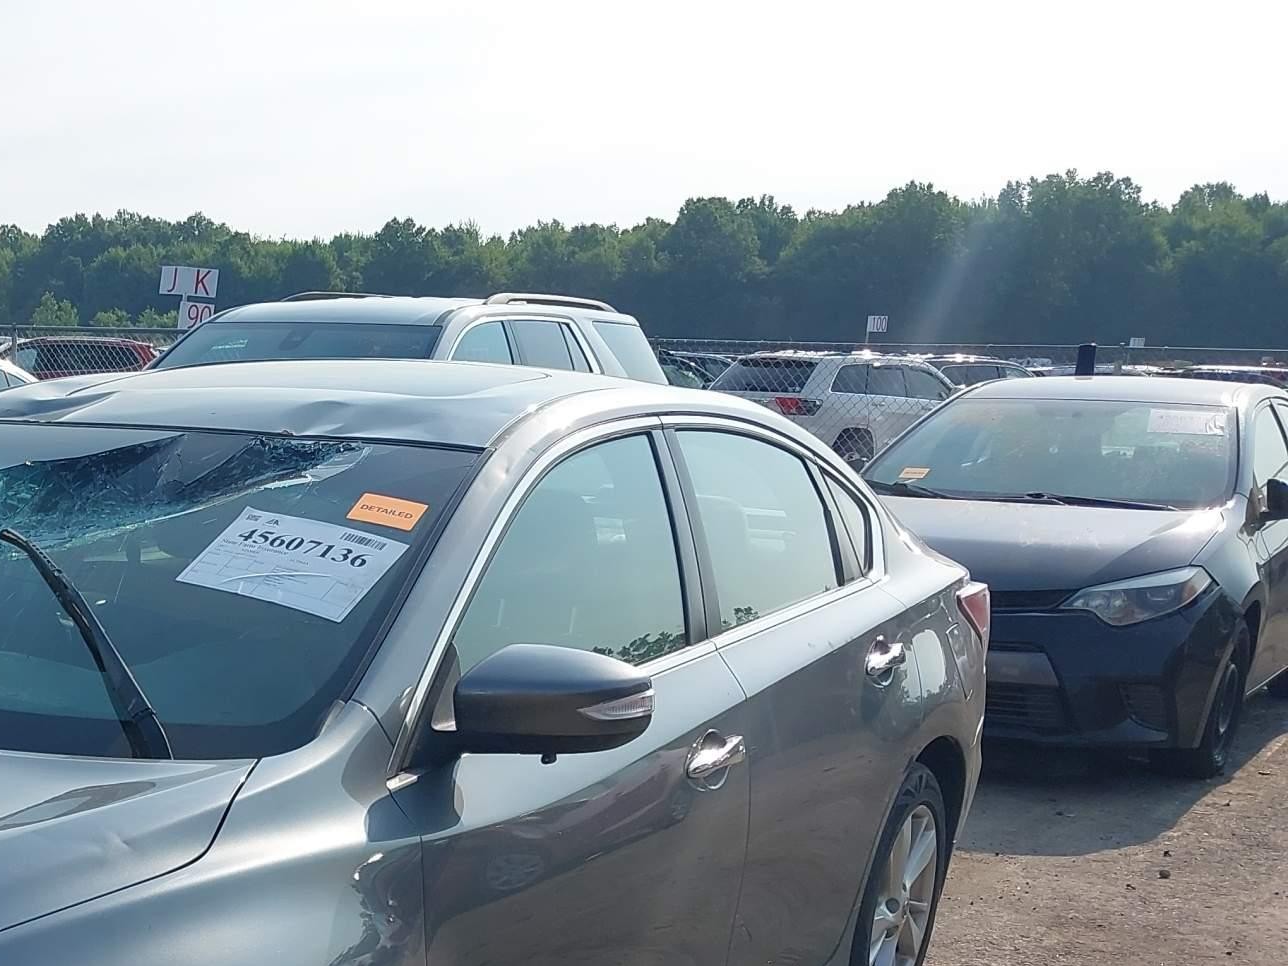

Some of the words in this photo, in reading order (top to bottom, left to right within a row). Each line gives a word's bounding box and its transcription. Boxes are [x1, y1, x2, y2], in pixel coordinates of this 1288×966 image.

[167, 267, 178, 293] J
[194, 269, 212, 296] K
[872, 316, 887, 331] 100
[360, 504, 413, 519] DETAILED
[238, 528, 374, 568] 45607136
